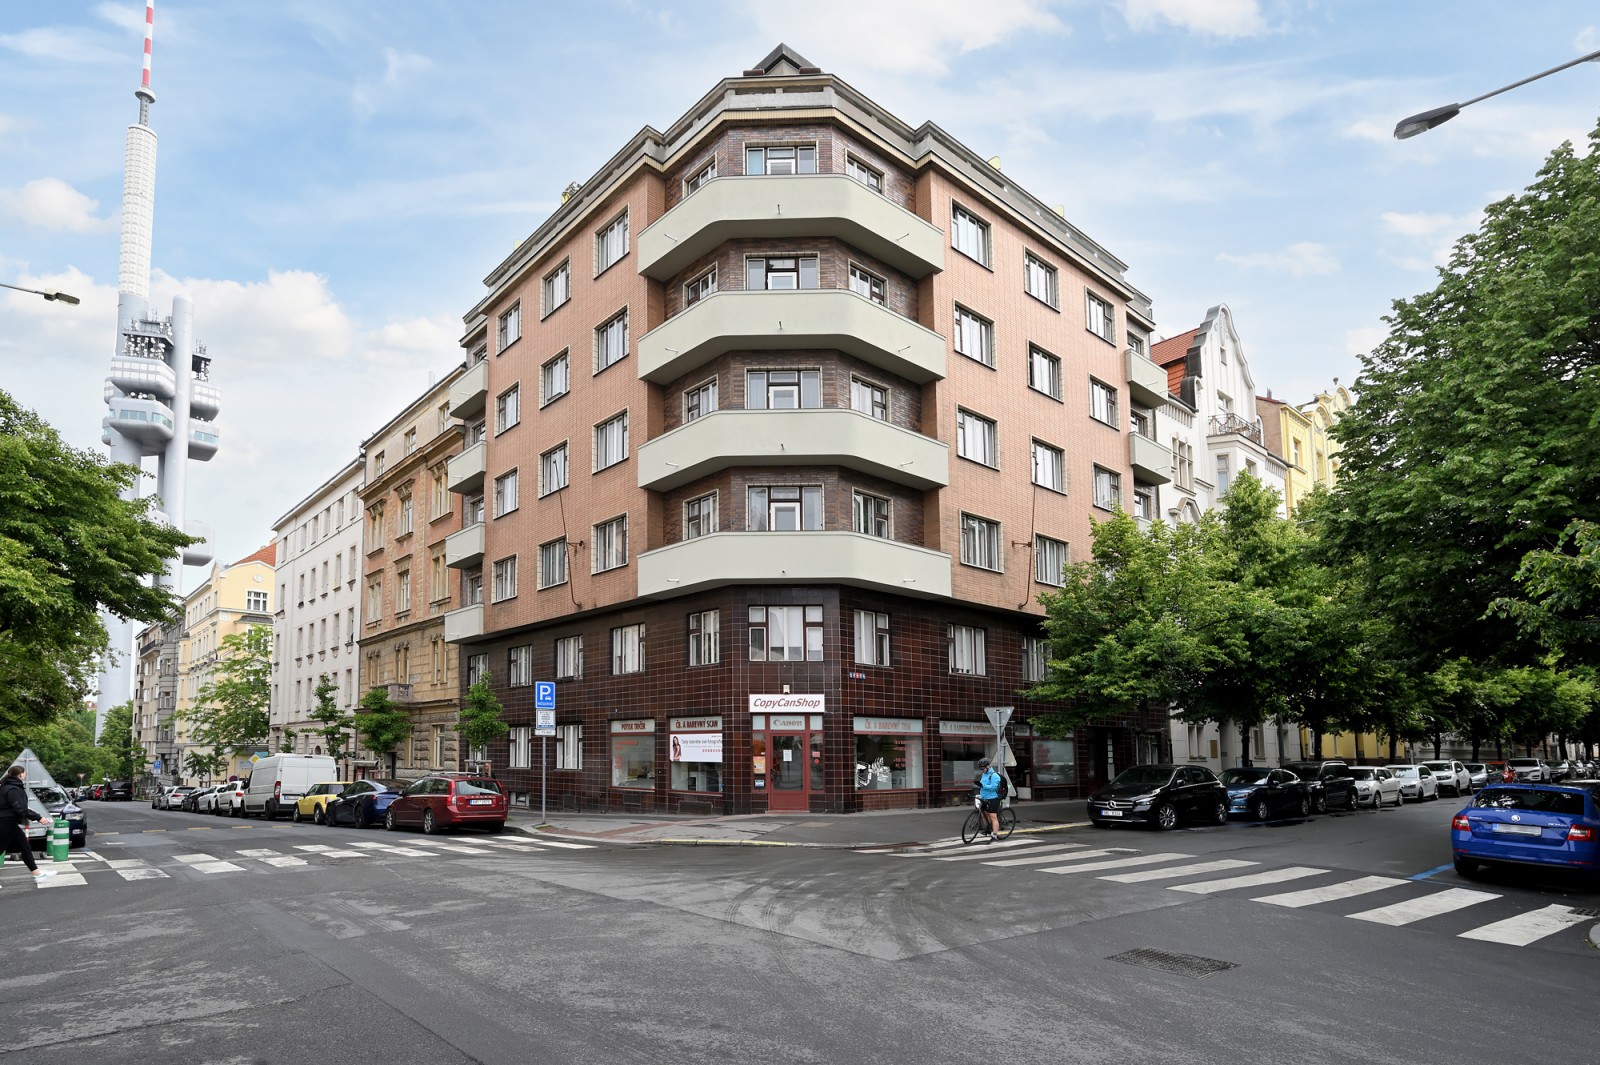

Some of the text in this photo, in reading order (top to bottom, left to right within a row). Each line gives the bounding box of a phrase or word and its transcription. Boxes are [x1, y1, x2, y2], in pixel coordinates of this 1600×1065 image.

[540, 685, 551, 700] P
[753, 698, 821, 709] CopyCanShop
[686, 718, 706, 728] BAREVNÝ
[706, 720, 718, 728] SCAN
[773, 719, 803, 727] Canon
